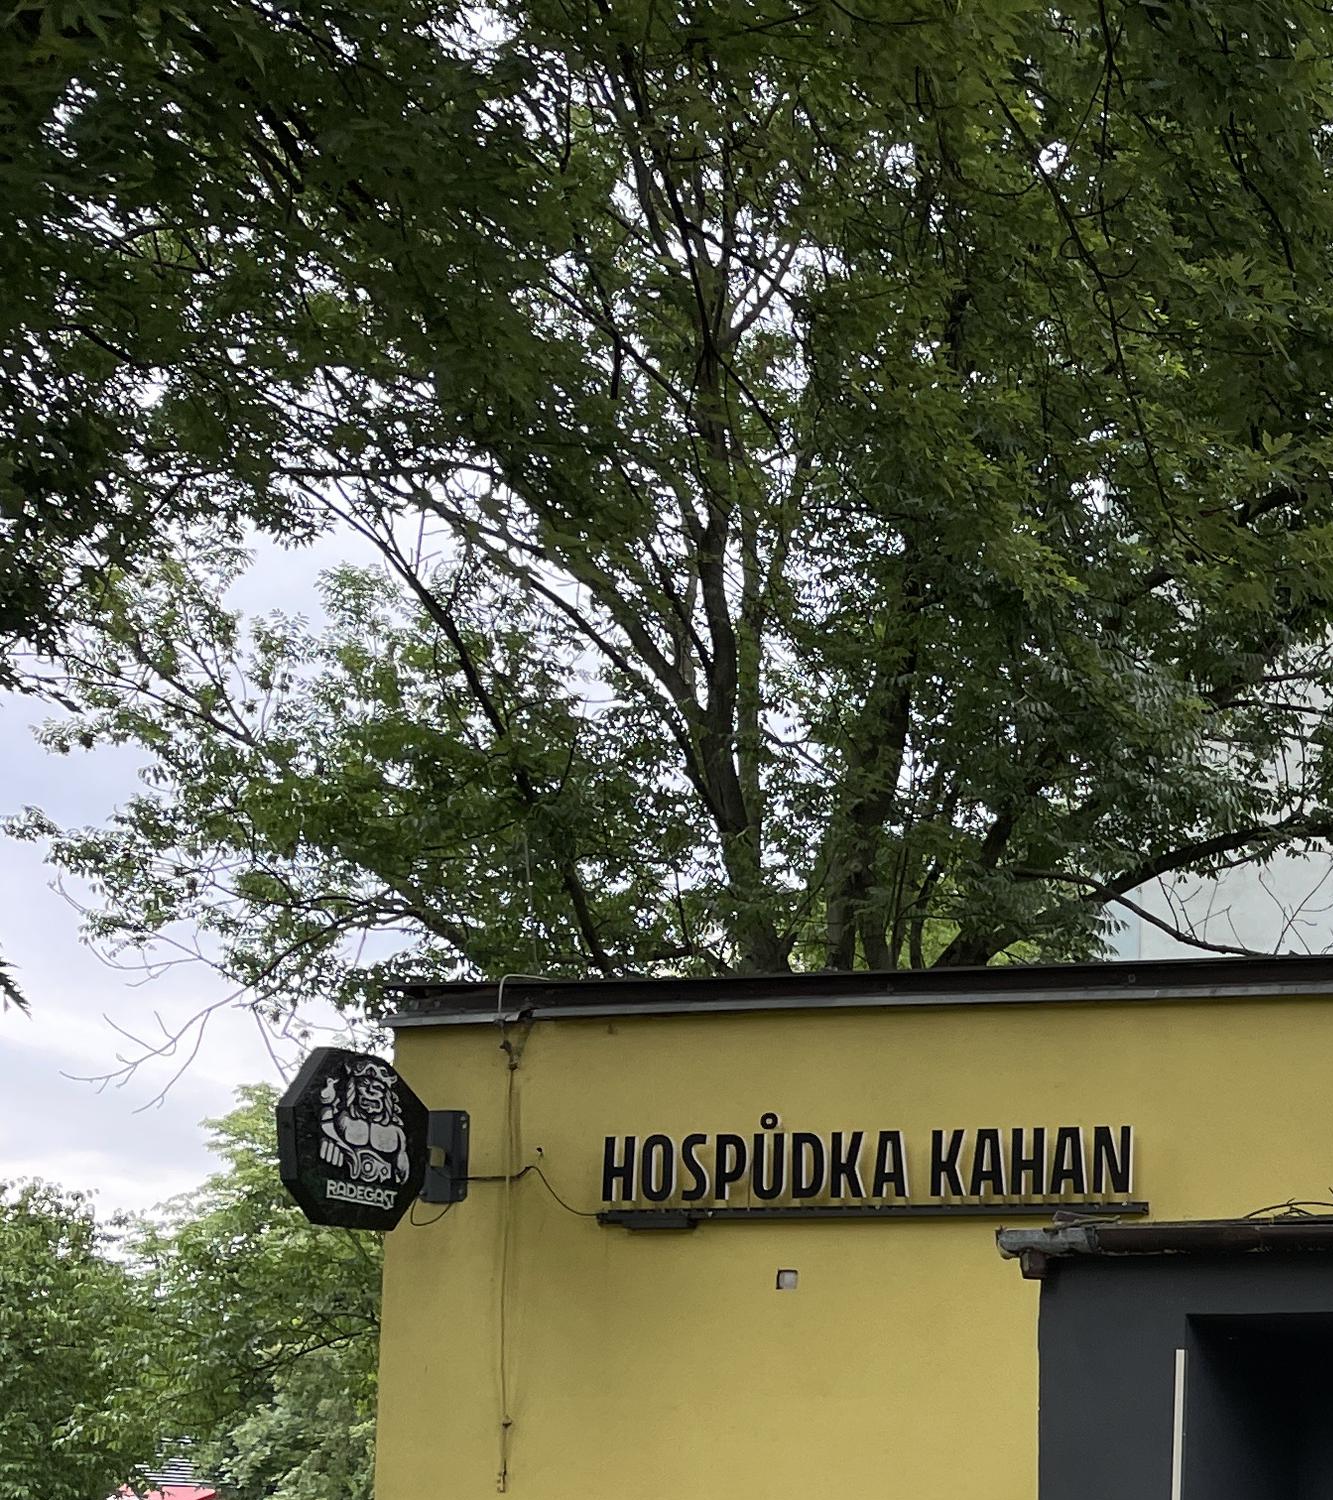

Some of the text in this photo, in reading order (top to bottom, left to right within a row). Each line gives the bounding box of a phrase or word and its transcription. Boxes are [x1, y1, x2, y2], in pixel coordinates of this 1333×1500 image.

[602, 1112, 1135, 1202] HOSPŮDKA KAHAN
[325, 1178, 398, 1210] RADEGAST
